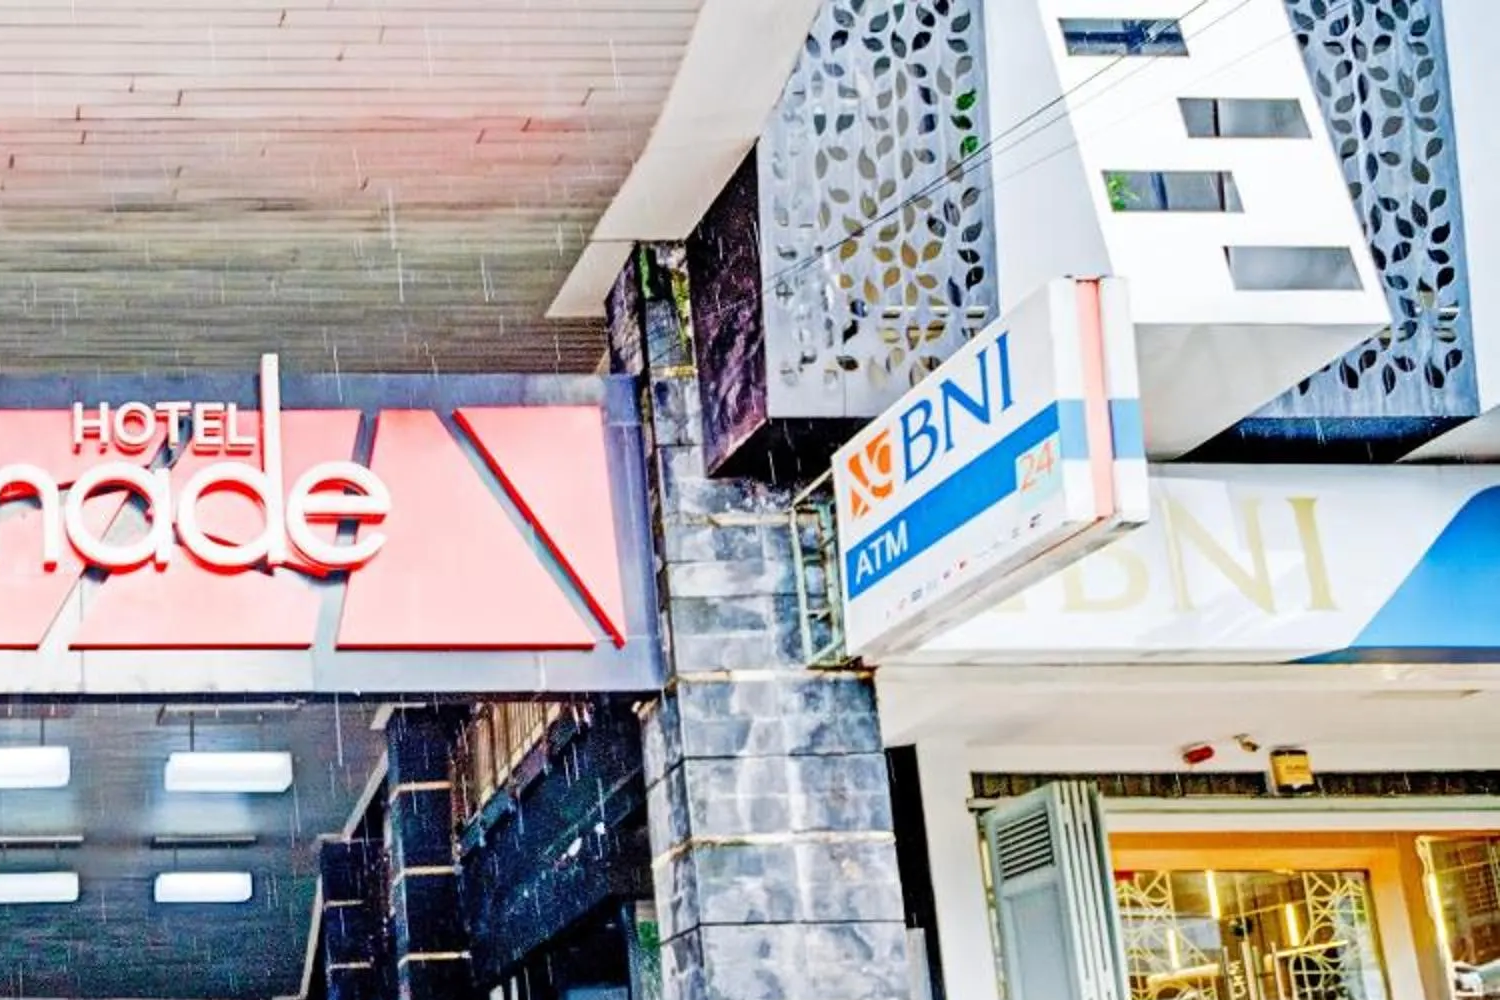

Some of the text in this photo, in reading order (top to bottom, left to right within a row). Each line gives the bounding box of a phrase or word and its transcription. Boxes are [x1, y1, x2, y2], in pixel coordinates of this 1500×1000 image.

[72, 401, 256, 454] HOTEL
[900, 330, 1014, 482] BNI
[1020, 440, 1056, 491] 24
[855, 519, 910, 584] ATM
